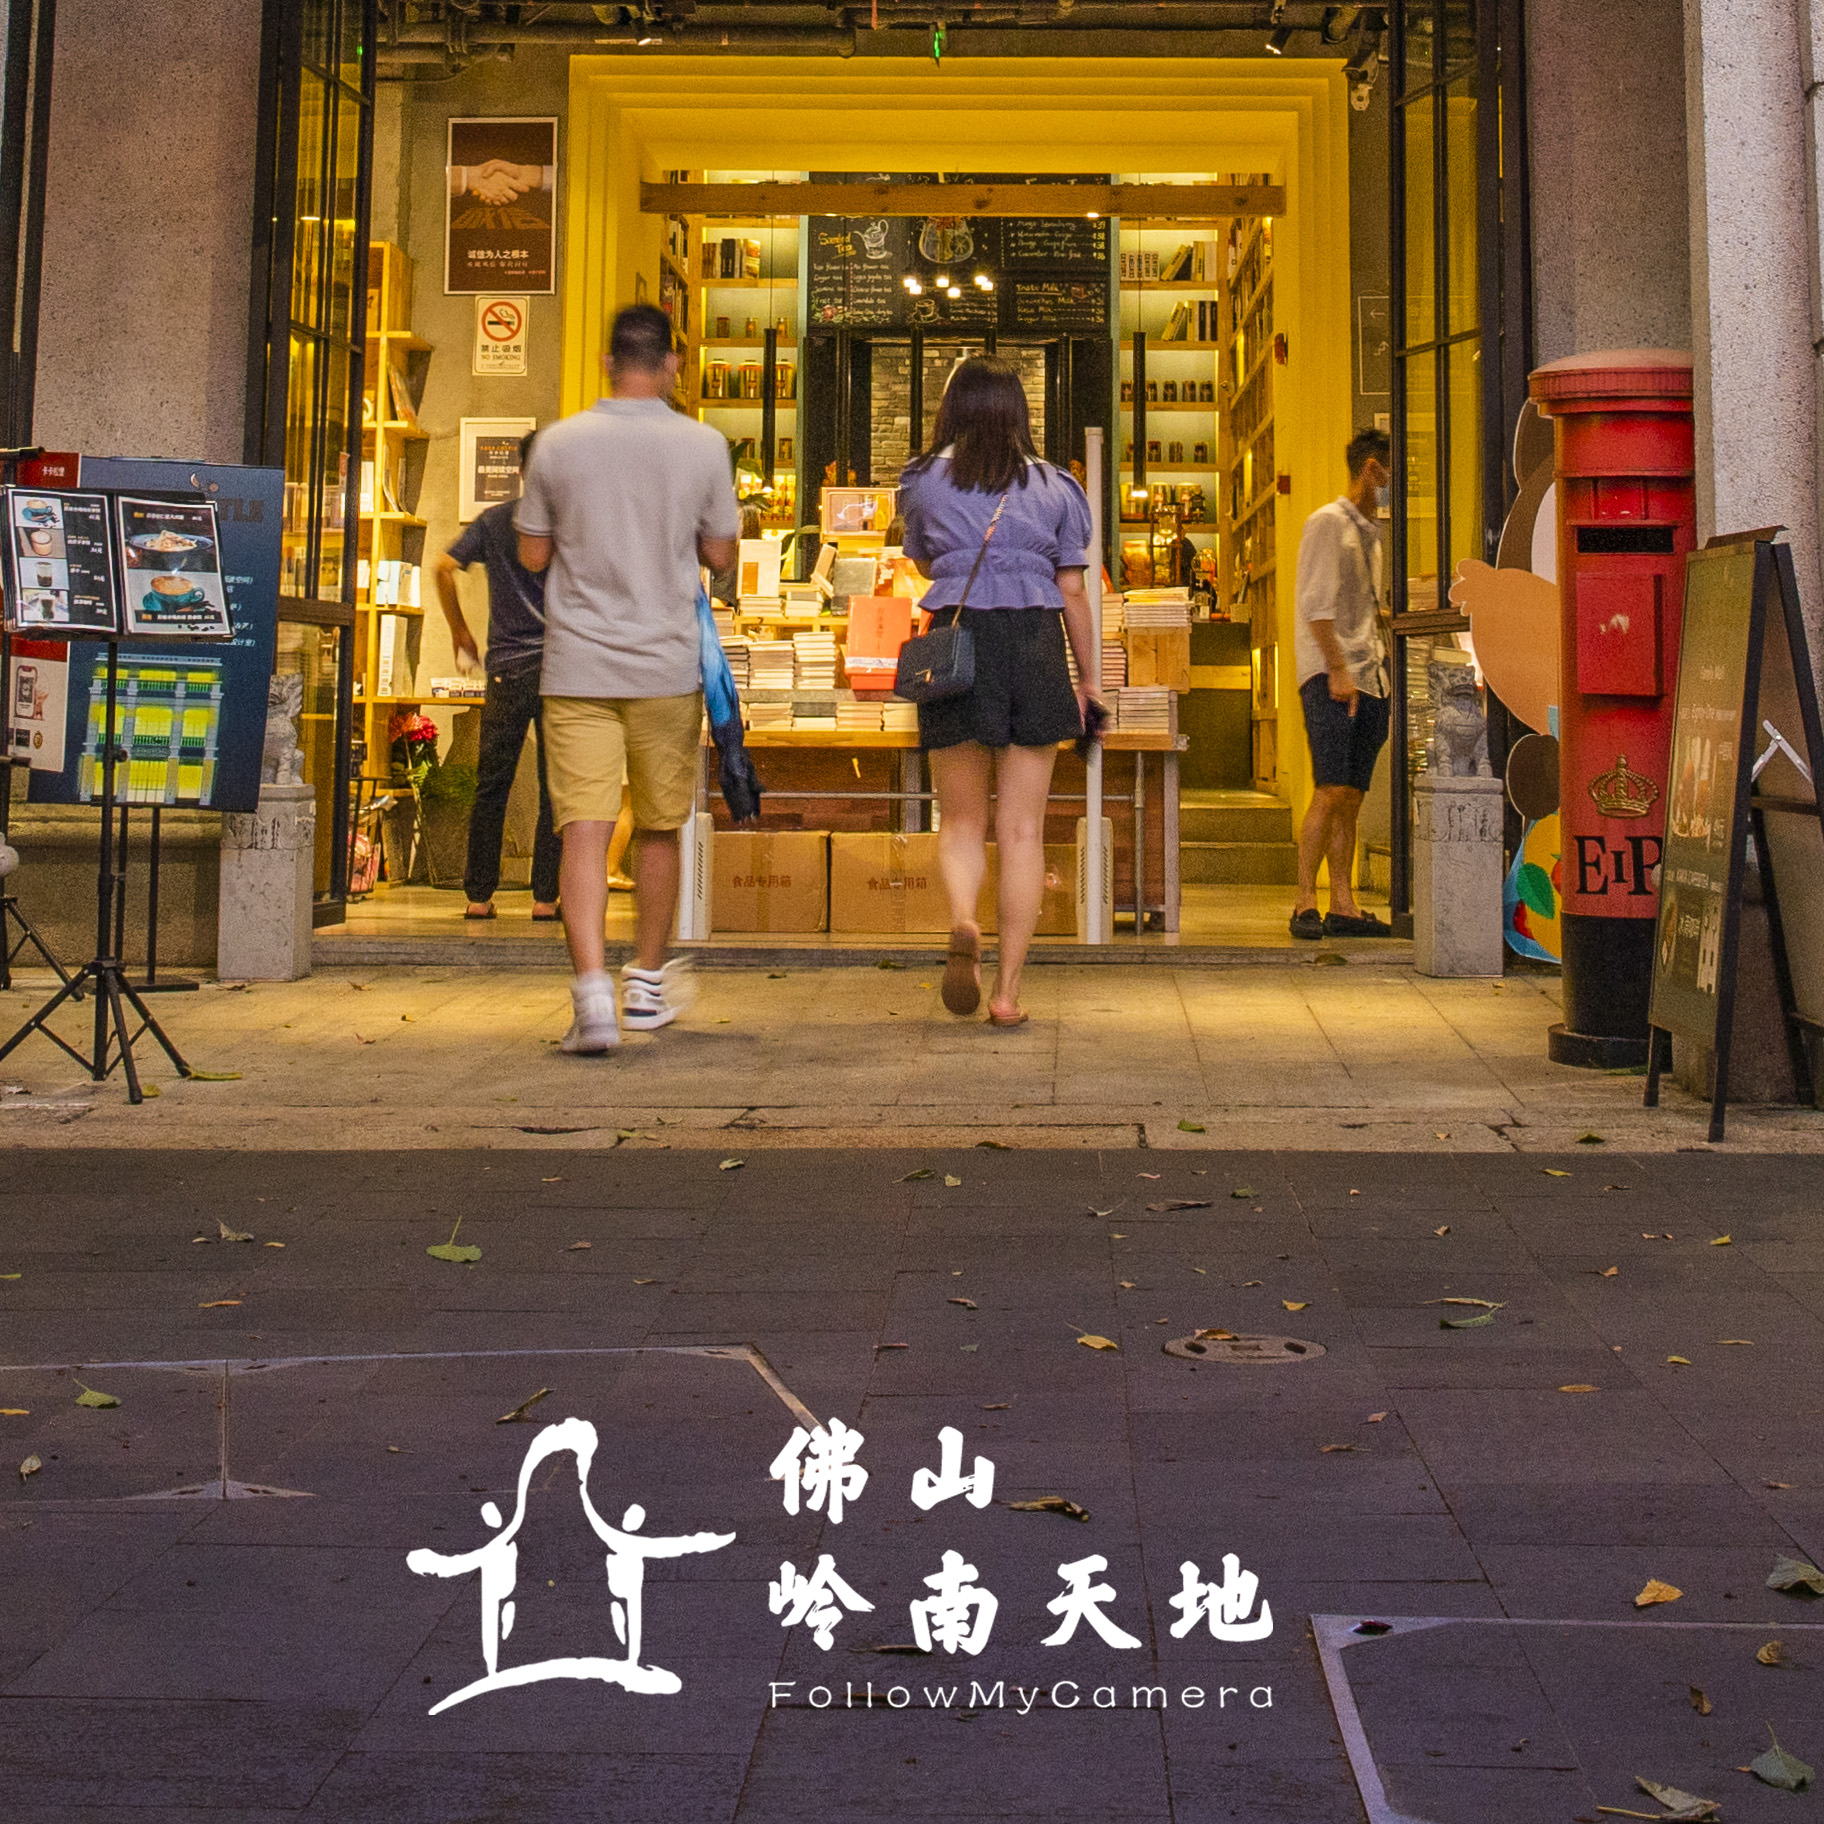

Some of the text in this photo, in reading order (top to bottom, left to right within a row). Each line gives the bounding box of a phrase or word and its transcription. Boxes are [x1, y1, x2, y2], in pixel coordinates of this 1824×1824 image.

[732, 875, 792, 888] 食品专用箱
